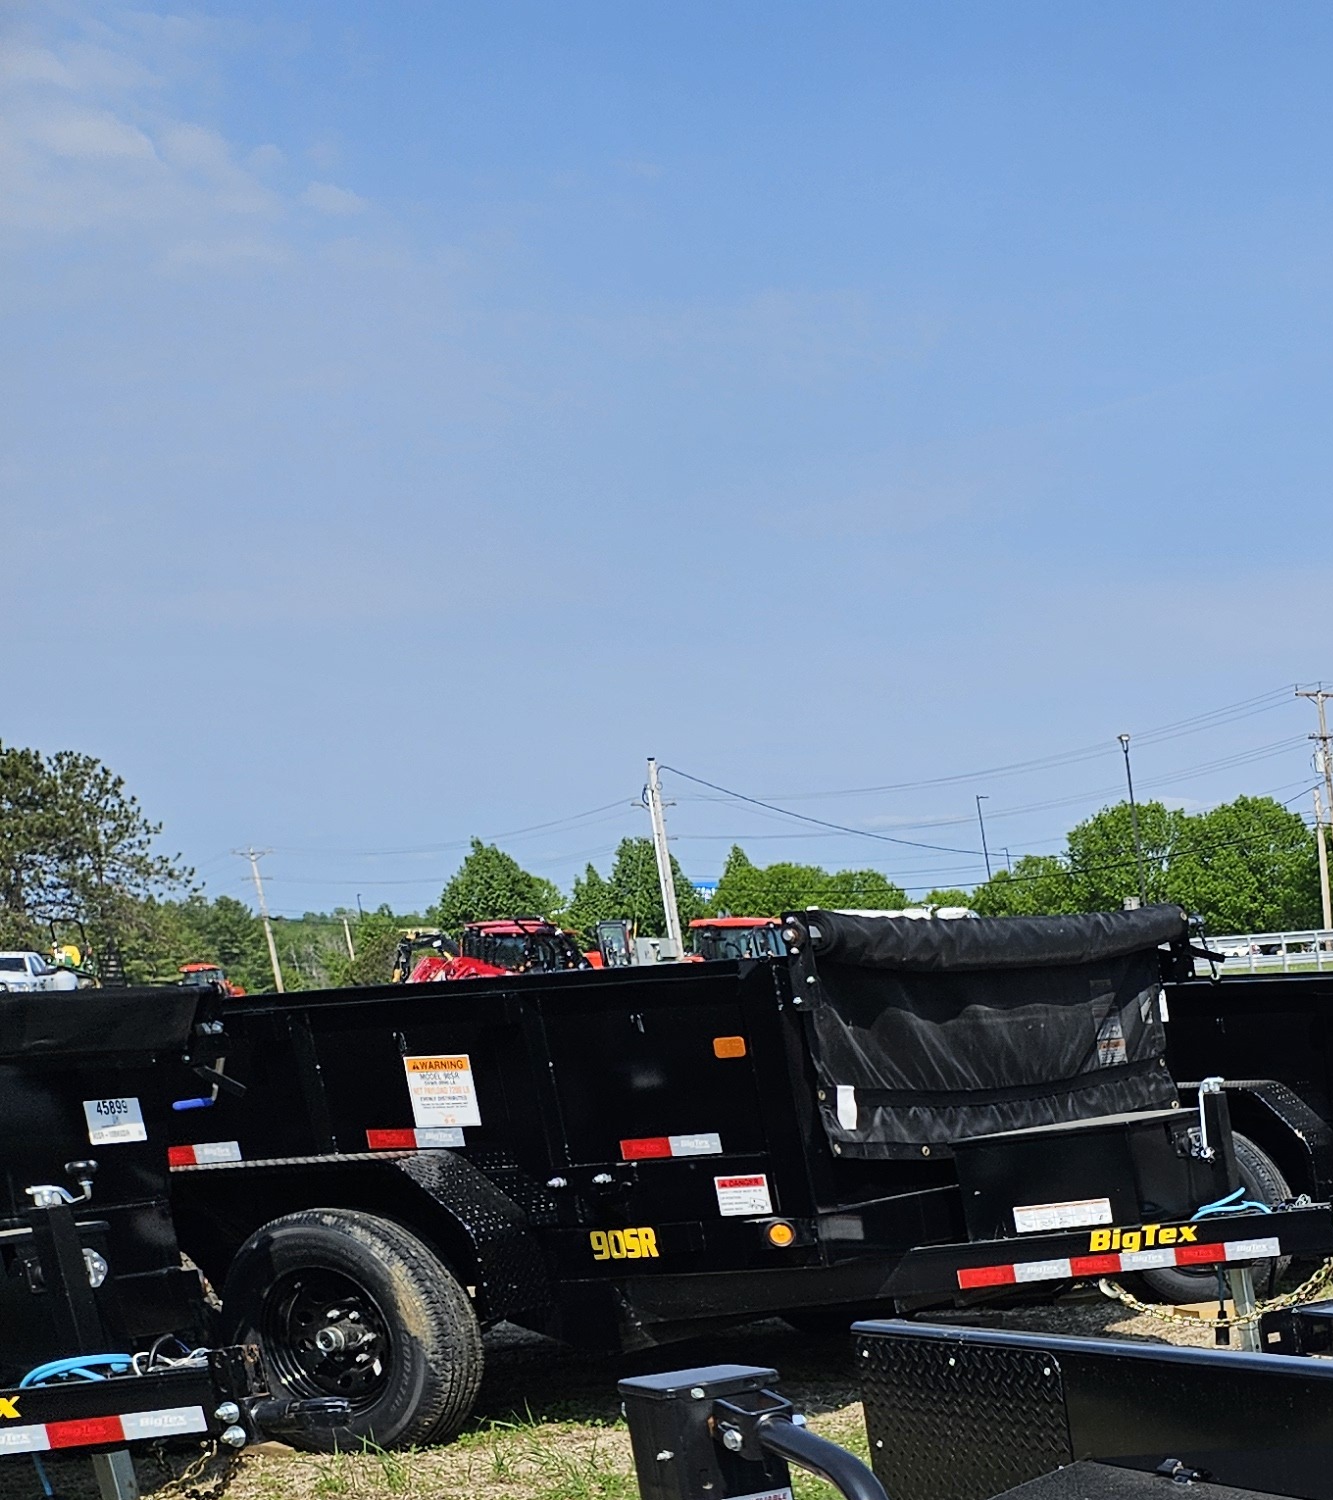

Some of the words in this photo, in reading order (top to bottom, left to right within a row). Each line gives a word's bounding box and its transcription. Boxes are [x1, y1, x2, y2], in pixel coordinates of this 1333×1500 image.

[419, 1060, 463, 1070] WARNING
[97, 1100, 128, 1115] 45899
[590, 1227, 659, 1260] 90SR
[1089, 1224, 1197, 1253] BigTex
[140, 1414, 187, 1428] BigTex
